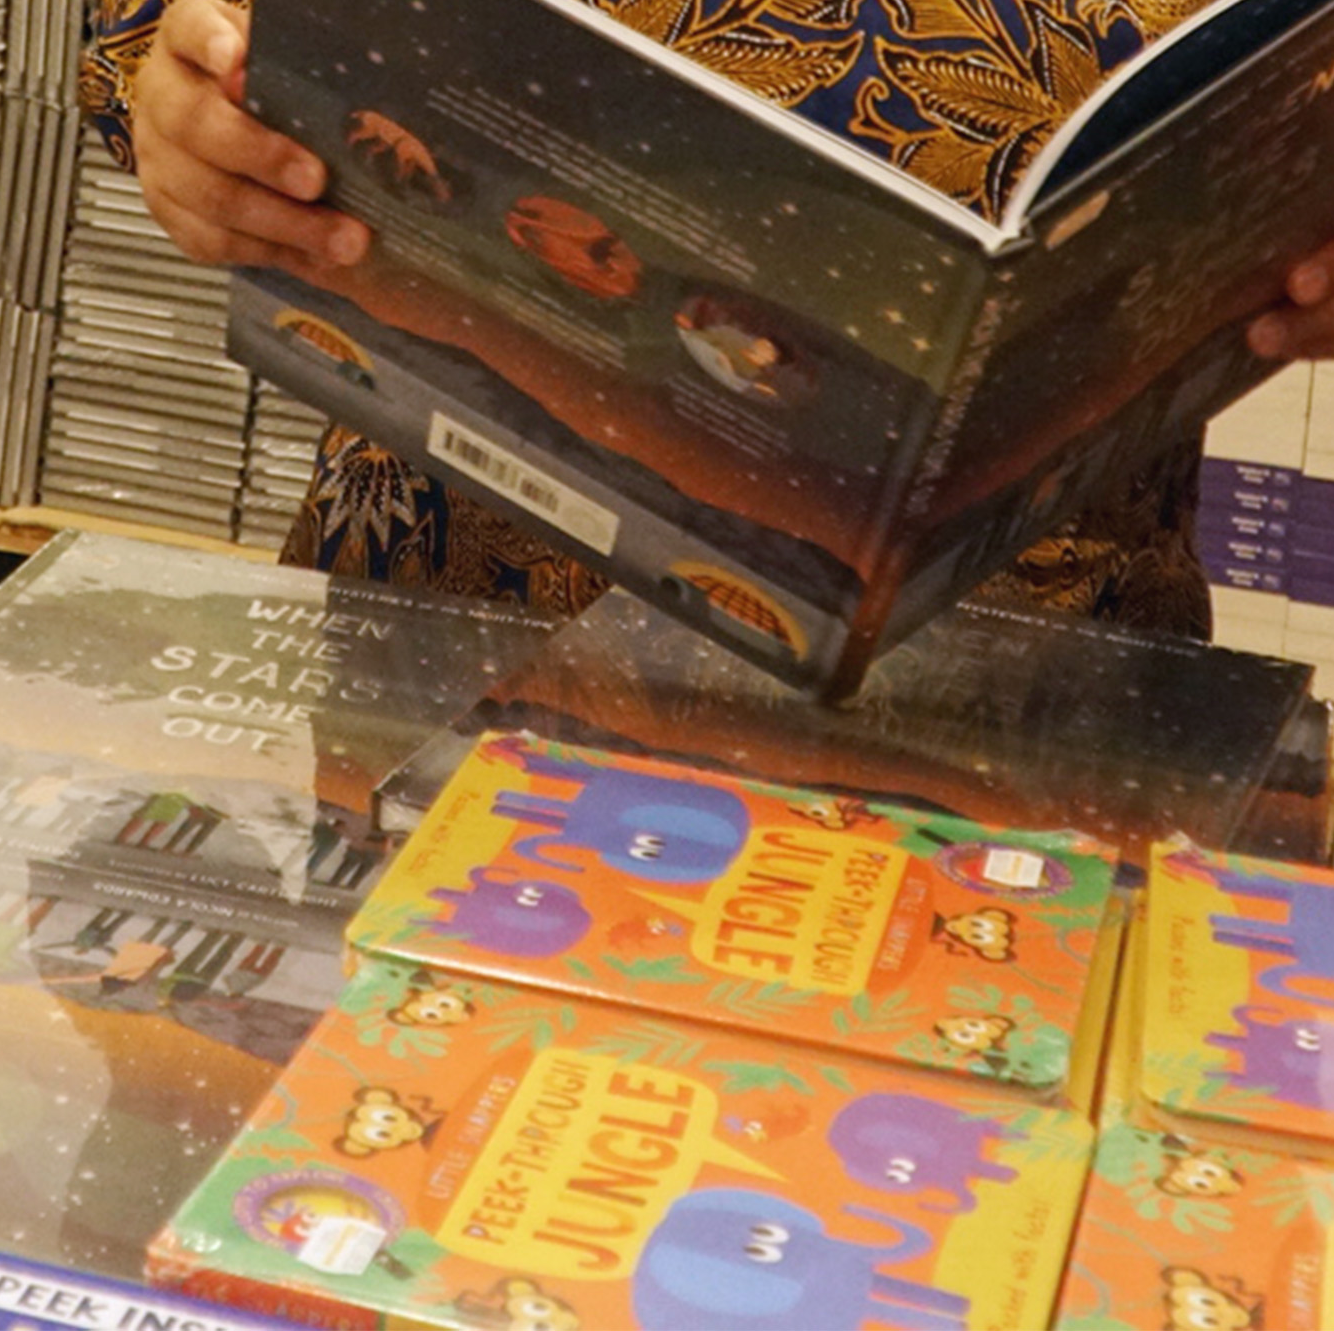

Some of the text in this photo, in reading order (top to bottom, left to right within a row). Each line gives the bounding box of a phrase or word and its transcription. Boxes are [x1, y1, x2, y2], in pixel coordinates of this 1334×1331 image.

[246, 599, 394, 641] WHEN
[249, 629, 353, 664] THE
[150, 645, 385, 704] STARS
[162, 716, 283, 754] OUT
[167, 685, 327, 728] COME
[712, 831, 835, 975] JUNGLE
[810, 848, 890, 987] PEEK-THROUGH
[460, 1057, 593, 1246] PEEK-THROUGH
[531, 1070, 696, 1273] JUNGLE
